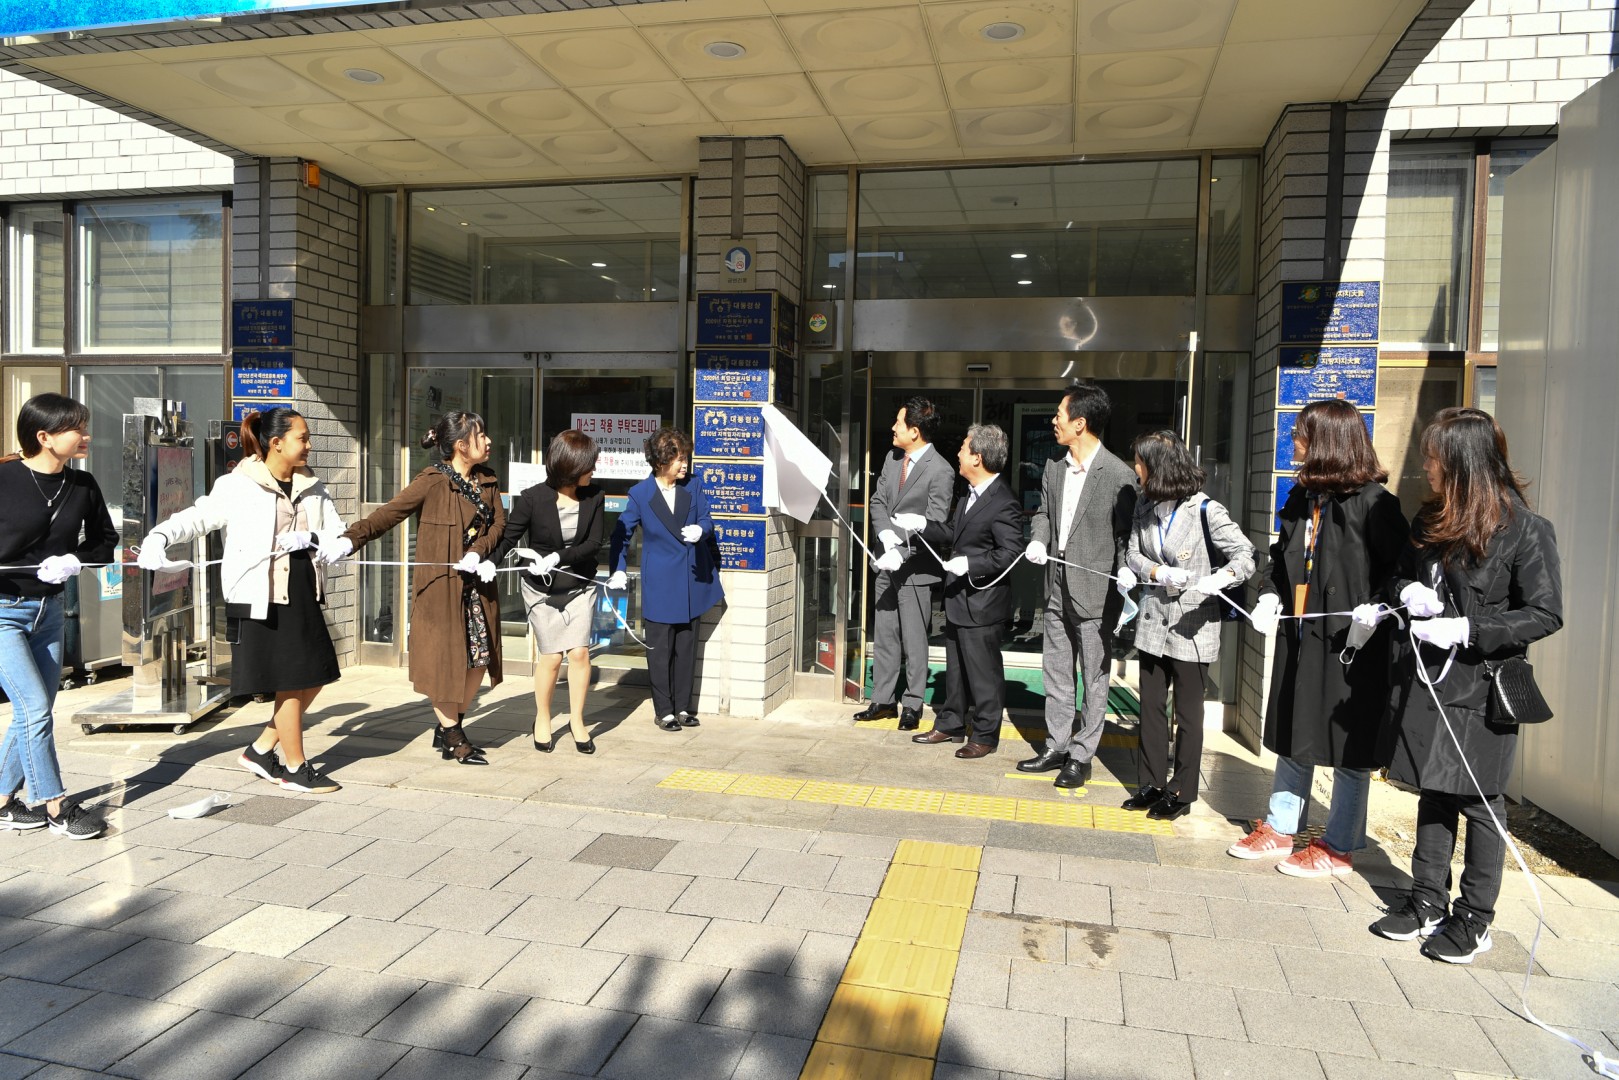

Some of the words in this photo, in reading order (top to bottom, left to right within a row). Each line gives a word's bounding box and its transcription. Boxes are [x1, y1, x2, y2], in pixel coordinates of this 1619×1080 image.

[733, 301, 761, 310] 대통령상
[730, 415, 760, 424] 대통령상
[576, 418, 596, 432] 마스크
[600, 418, 613, 434] 착용
[617, 418, 657, 434] 부탁드립니다
[727, 473, 757, 482] 대통령상
[725, 529, 754, 538] 대통령상
